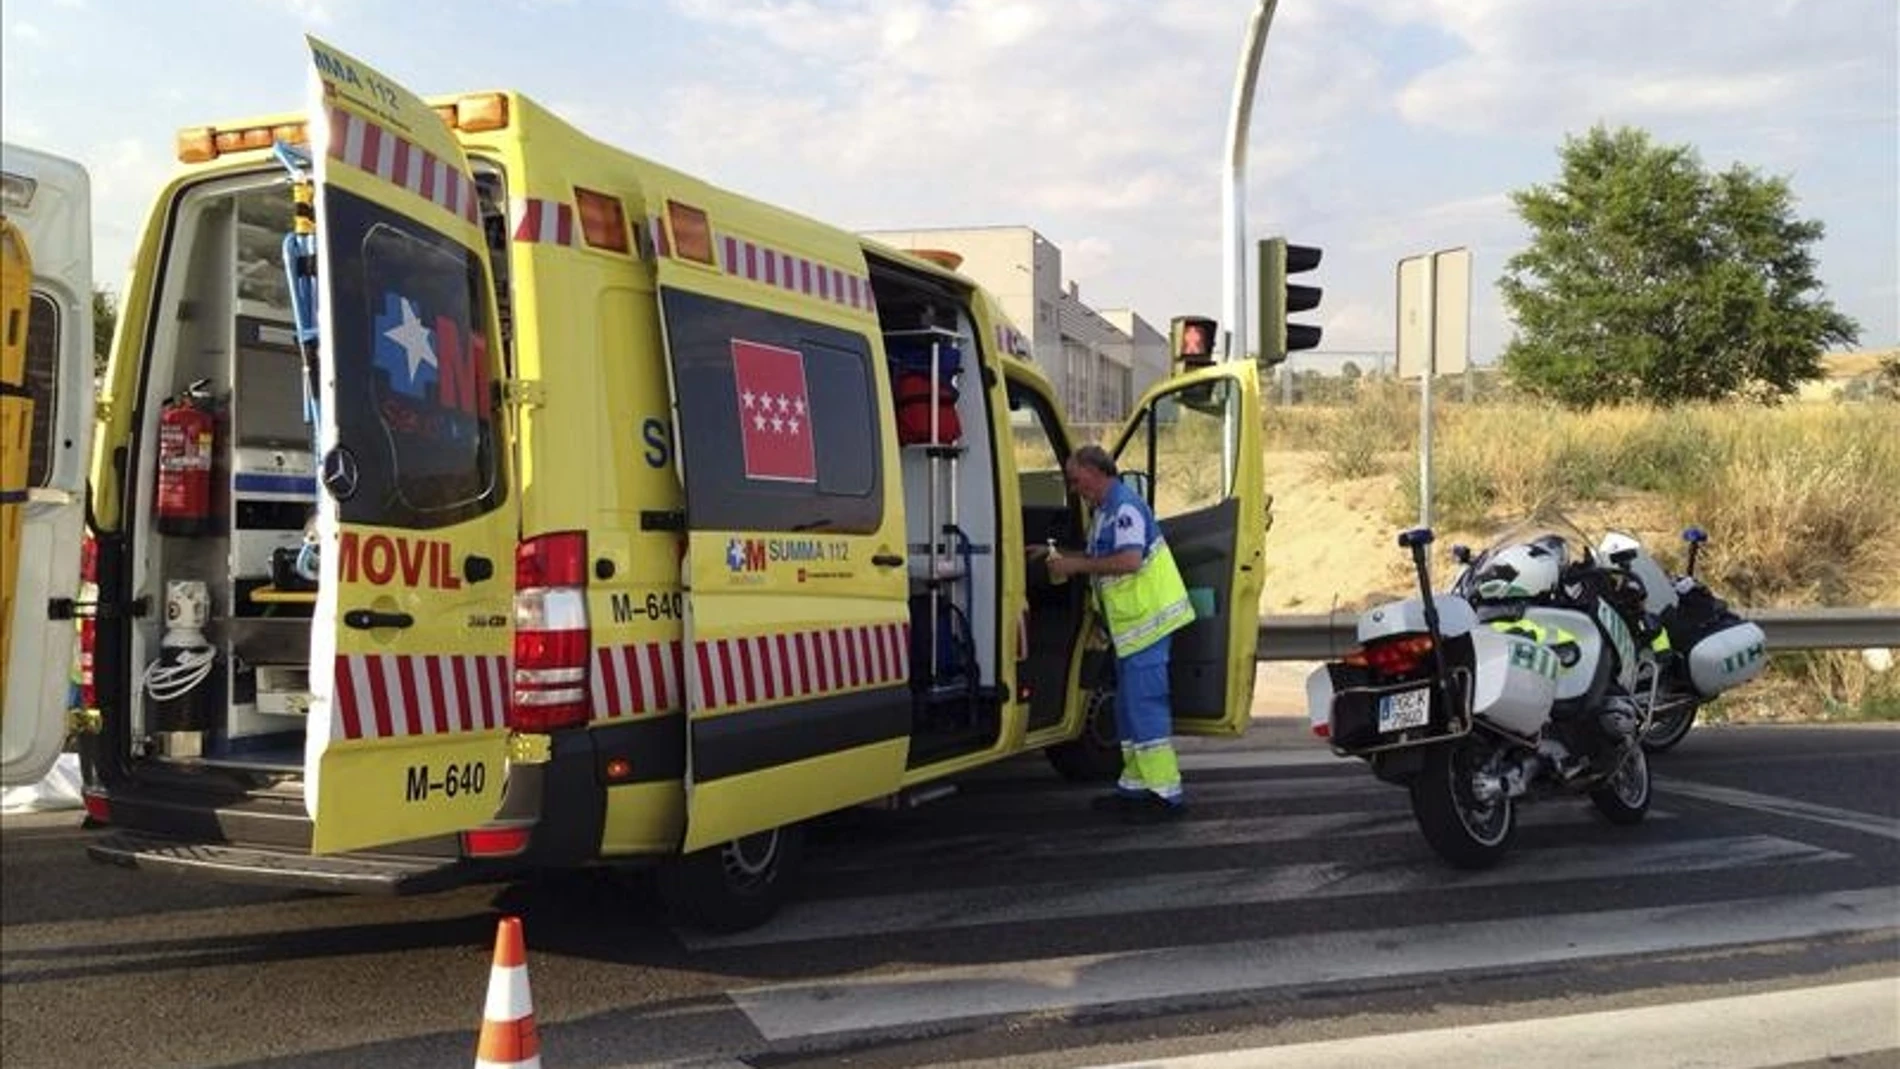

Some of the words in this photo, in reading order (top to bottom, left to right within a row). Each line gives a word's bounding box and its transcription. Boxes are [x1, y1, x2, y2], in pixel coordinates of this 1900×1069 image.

[769, 540, 825, 562] SUMMA
[828, 542, 849, 562] 112
[611, 592, 682, 624] M-640
[406, 762, 486, 801] M-640
